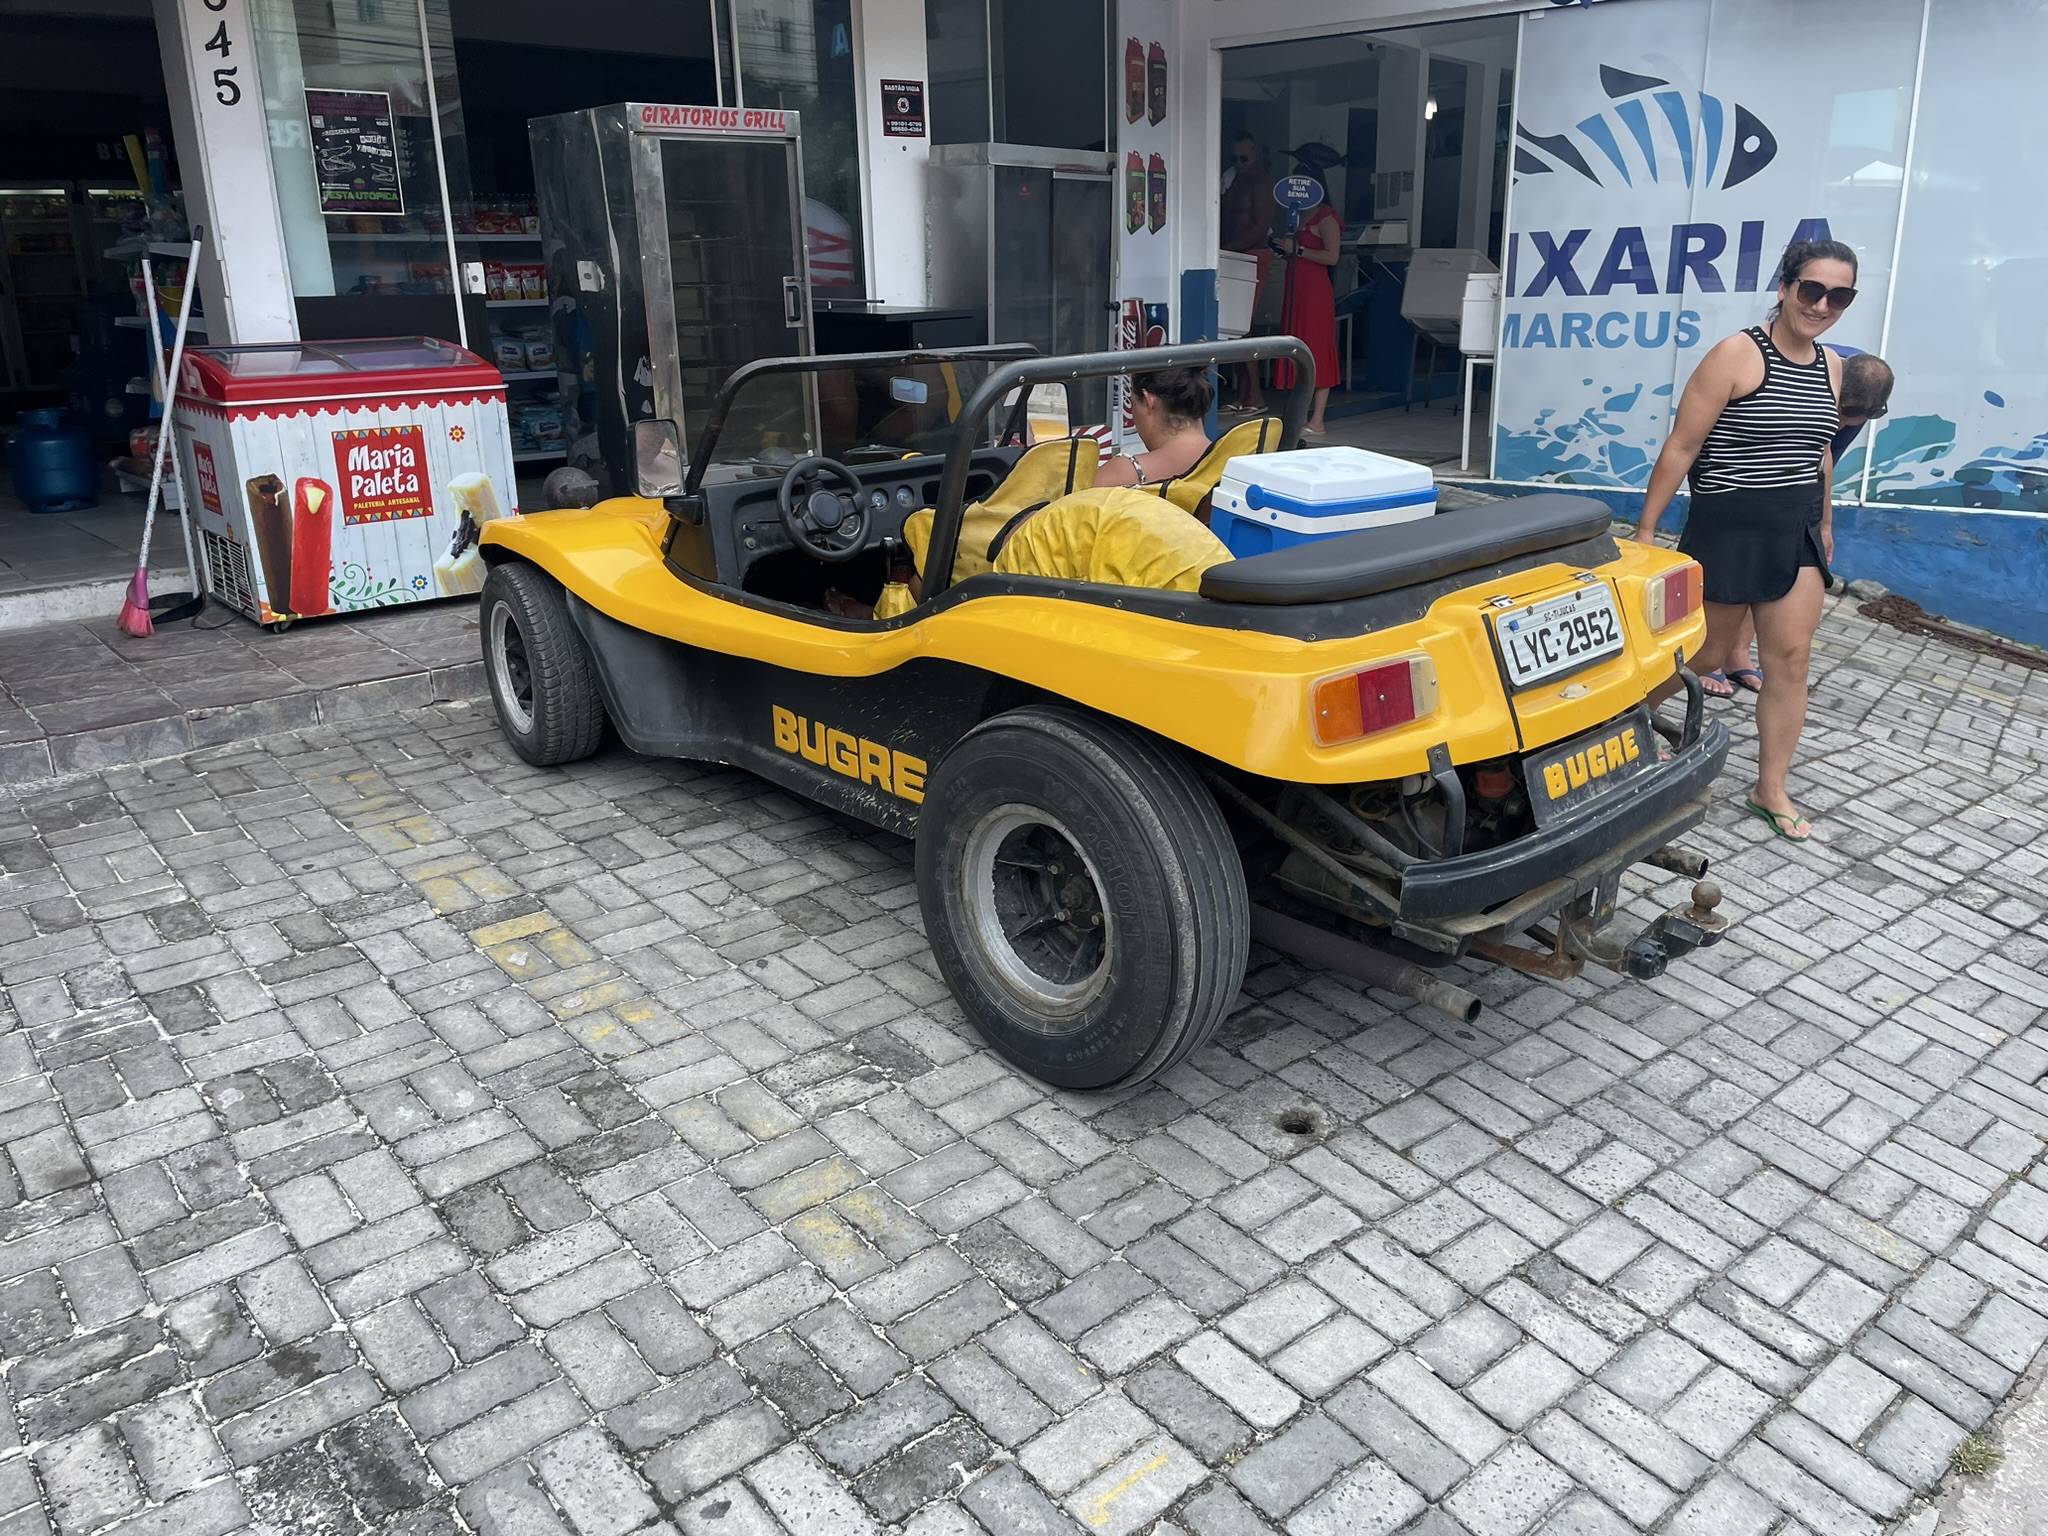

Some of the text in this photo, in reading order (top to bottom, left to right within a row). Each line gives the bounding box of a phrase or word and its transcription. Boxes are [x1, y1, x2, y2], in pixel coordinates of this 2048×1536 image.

[743, 111, 785, 129] GRILL
[348, 443, 416, 472] Maria
[351, 467, 419, 499] Paleta
[353, 497, 420, 510] PALETERIA ARTESANAL
[772, 703, 928, 806] BUGRE
[1543, 727, 1640, 801] BUGRE
